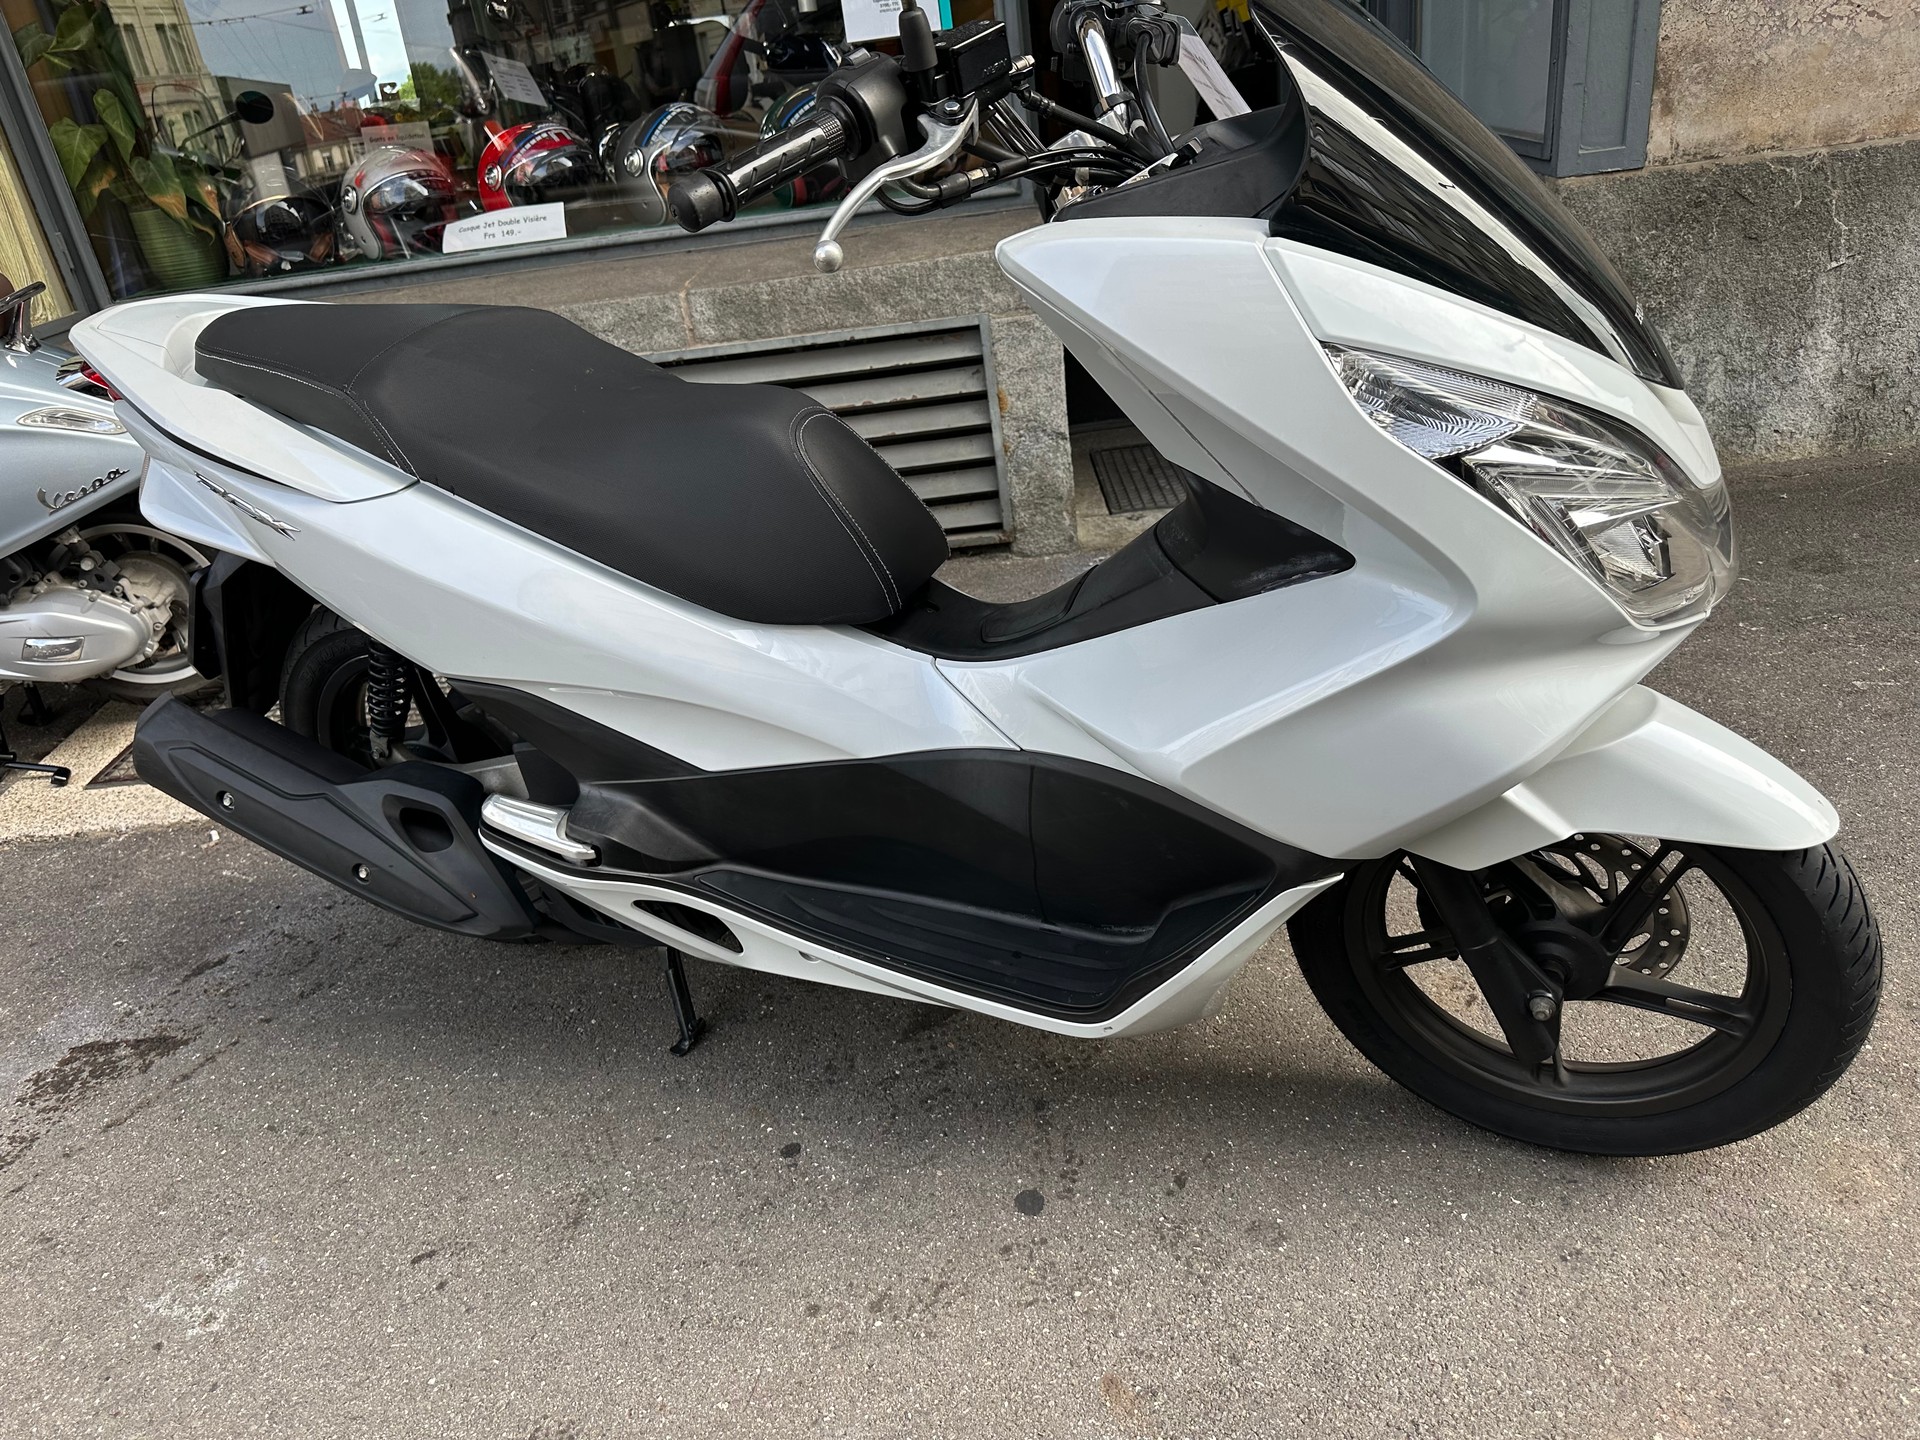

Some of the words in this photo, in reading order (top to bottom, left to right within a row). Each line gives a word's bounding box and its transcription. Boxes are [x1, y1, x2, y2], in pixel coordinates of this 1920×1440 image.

[458, 225, 481, 233] Casque
[498, 219, 521, 227] Double
[523, 215, 547, 223] Visière
[484, 232, 496, 240] Frs
[36, 467, 130, 517] Vespa
